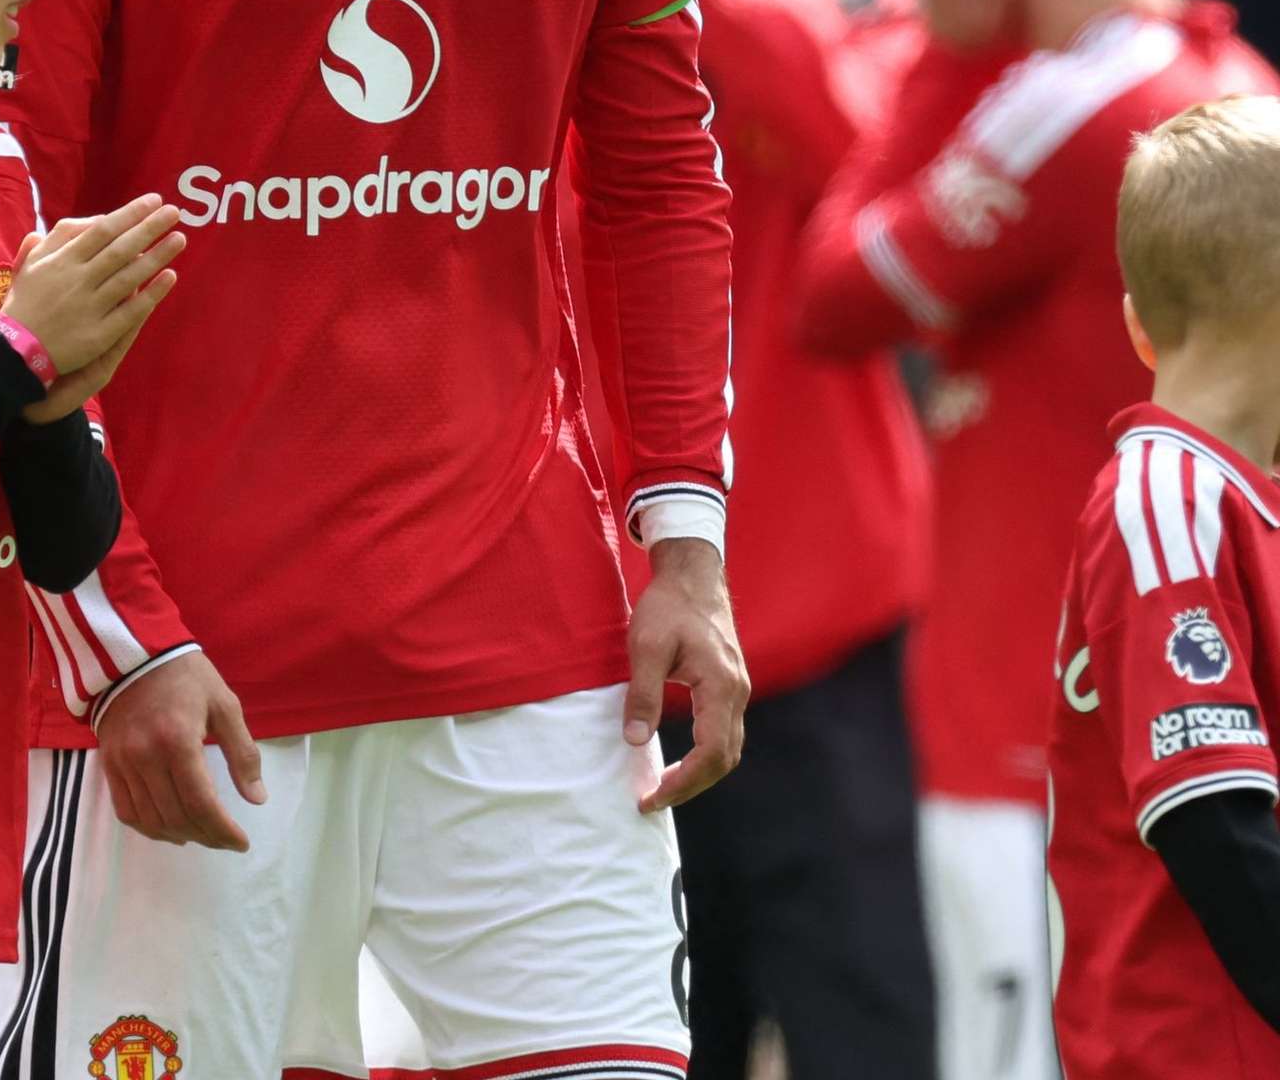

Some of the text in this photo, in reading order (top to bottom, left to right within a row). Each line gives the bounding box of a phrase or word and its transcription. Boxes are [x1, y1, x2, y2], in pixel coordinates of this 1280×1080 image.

[1151, 706, 1250, 737] No room
[98, 1023, 171, 1053] MANCHESTER
